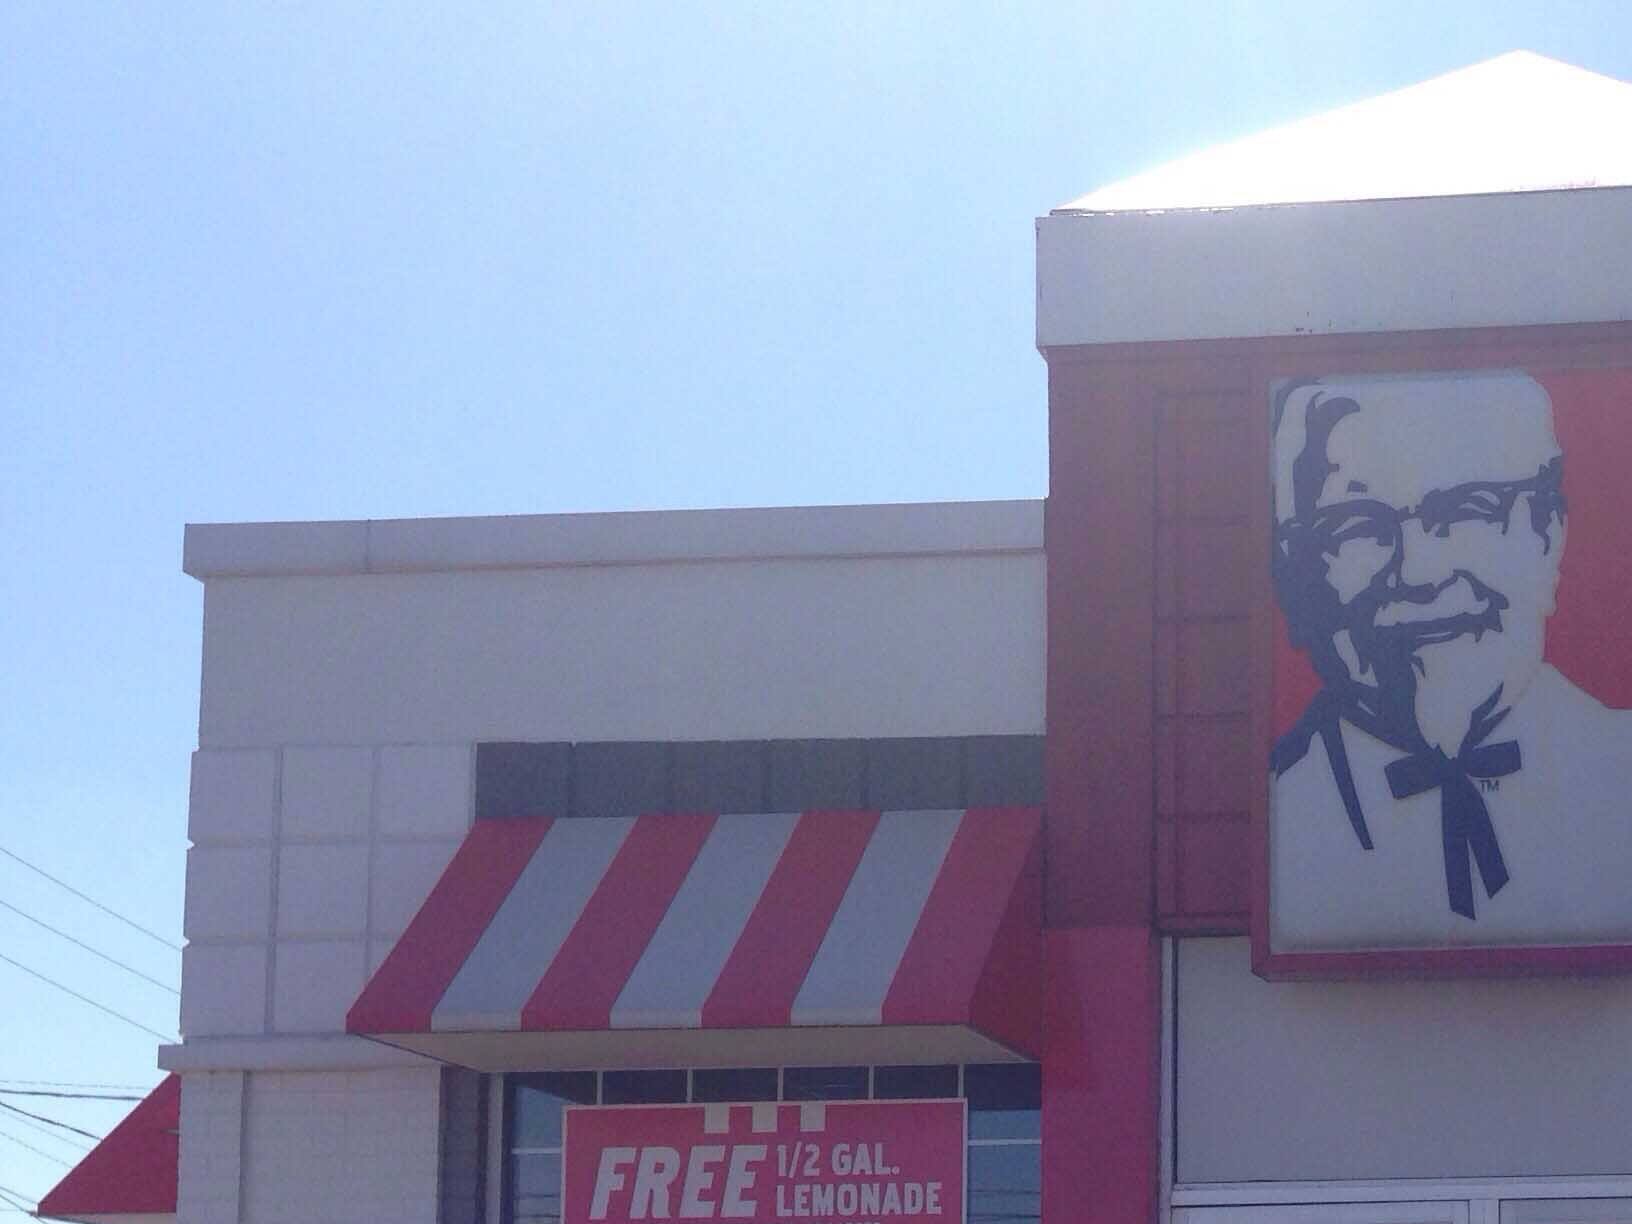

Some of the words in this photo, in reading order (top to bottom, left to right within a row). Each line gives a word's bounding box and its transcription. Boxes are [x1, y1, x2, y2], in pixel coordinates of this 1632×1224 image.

[1480, 780, 1500, 793] TM
[776, 1141, 819, 1179] 1/2
[831, 1142, 900, 1177] GAL.
[589, 1144, 769, 1221] FREE
[775, 1181, 943, 1217] LEMONADE
